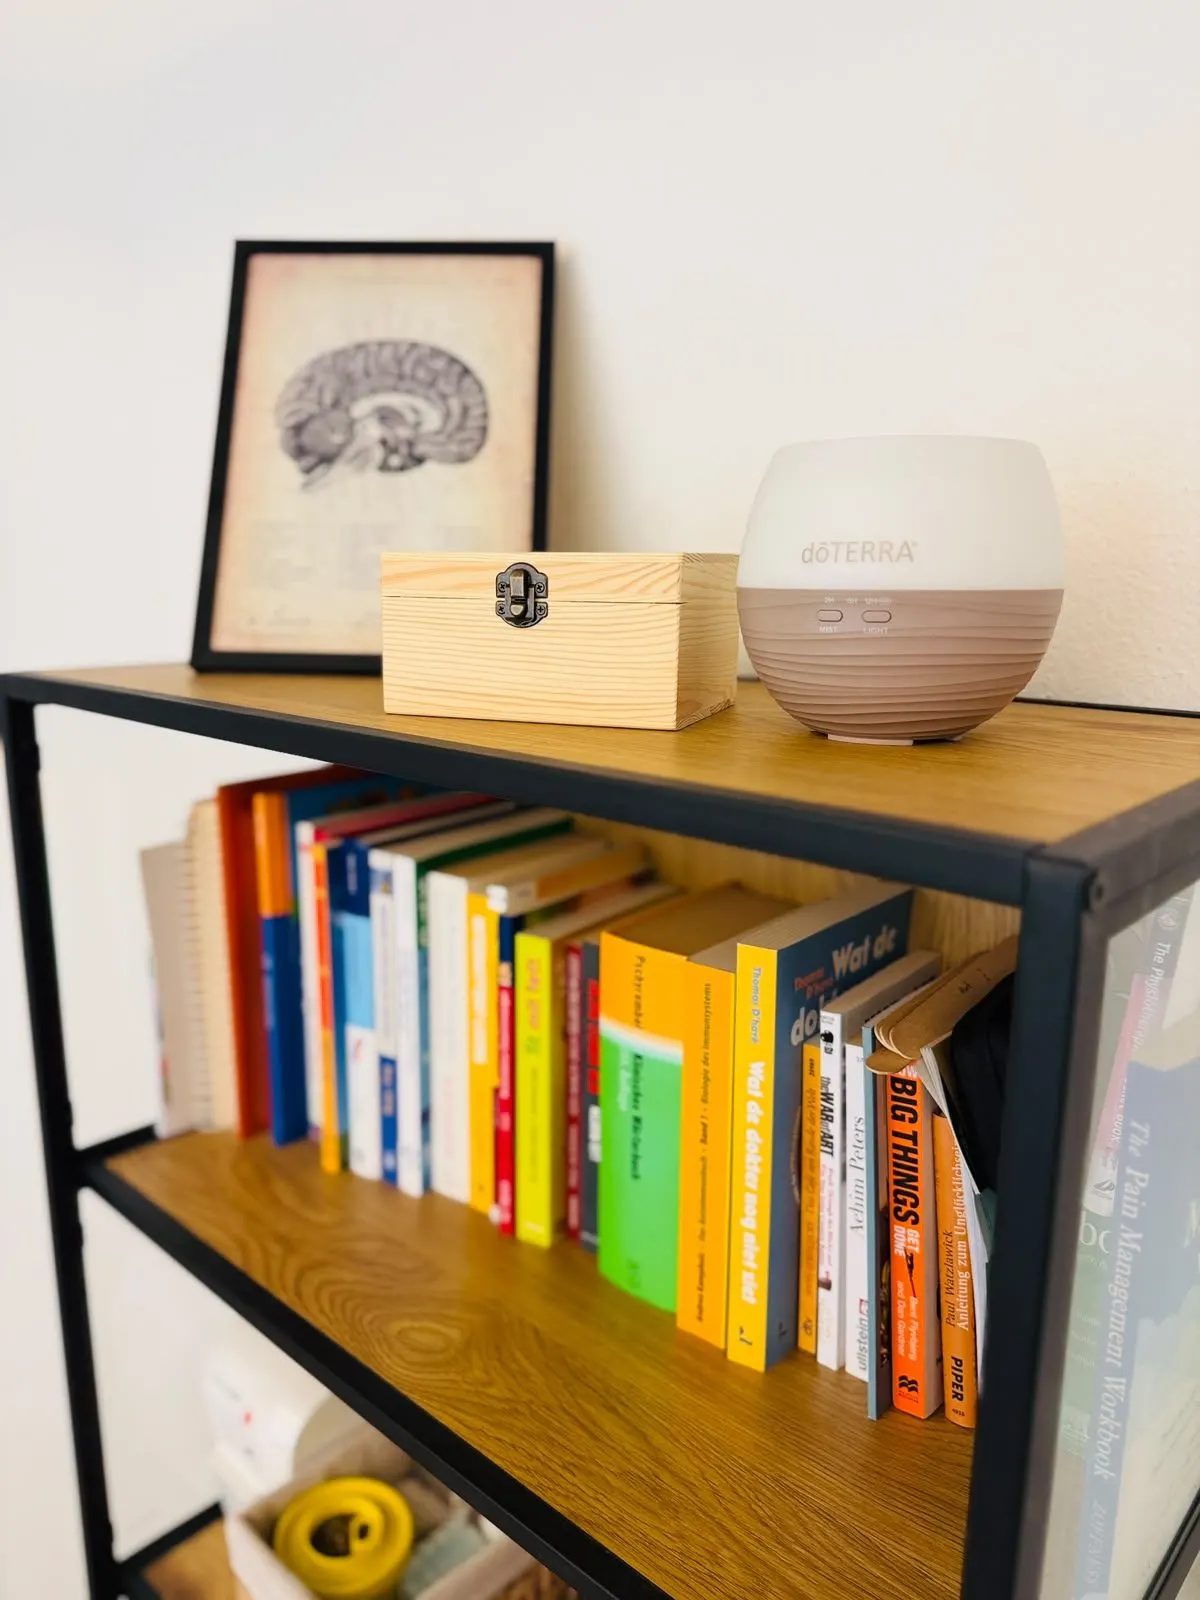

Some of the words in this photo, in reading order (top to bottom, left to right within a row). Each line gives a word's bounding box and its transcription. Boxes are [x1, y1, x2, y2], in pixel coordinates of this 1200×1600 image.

[832, 934, 871, 980] Wat
[1153, 941, 1171, 963] The
[752, 967, 761, 1005] Thomas
[747, 1061, 766, 1098] Wat
[890, 1075, 918, 1125] BIG
[746, 1100, 764, 1125] de
[820, 1091, 834, 1124] WAR
[744, 1128, 763, 1190] dokter
[820, 1130, 834, 1157] ART
[848, 1116, 865, 1171] Peters
[1128, 1119, 1150, 1157] The
[891, 1130, 920, 1226] THINGS
[1122, 1166, 1149, 1219] Pain
[740, 1192, 758, 1230] nog
[848, 1178, 865, 1239] Achim
[742, 1231, 760, 1269] niet
[893, 1225, 907, 1259] DONE
[907, 1228, 921, 1254] GET
[957, 1240, 967, 1266] zum
[943, 1230, 955, 1300] Watzlawick
[945, 1305, 956, 1328] Paul
[956, 1272, 970, 1331] Anleitung
[1104, 1224, 1143, 1368] Management
[856, 1316, 868, 1372] ullstein
[951, 1355, 964, 1402] PIPER
[1093, 1375, 1127, 1480] Workbook
